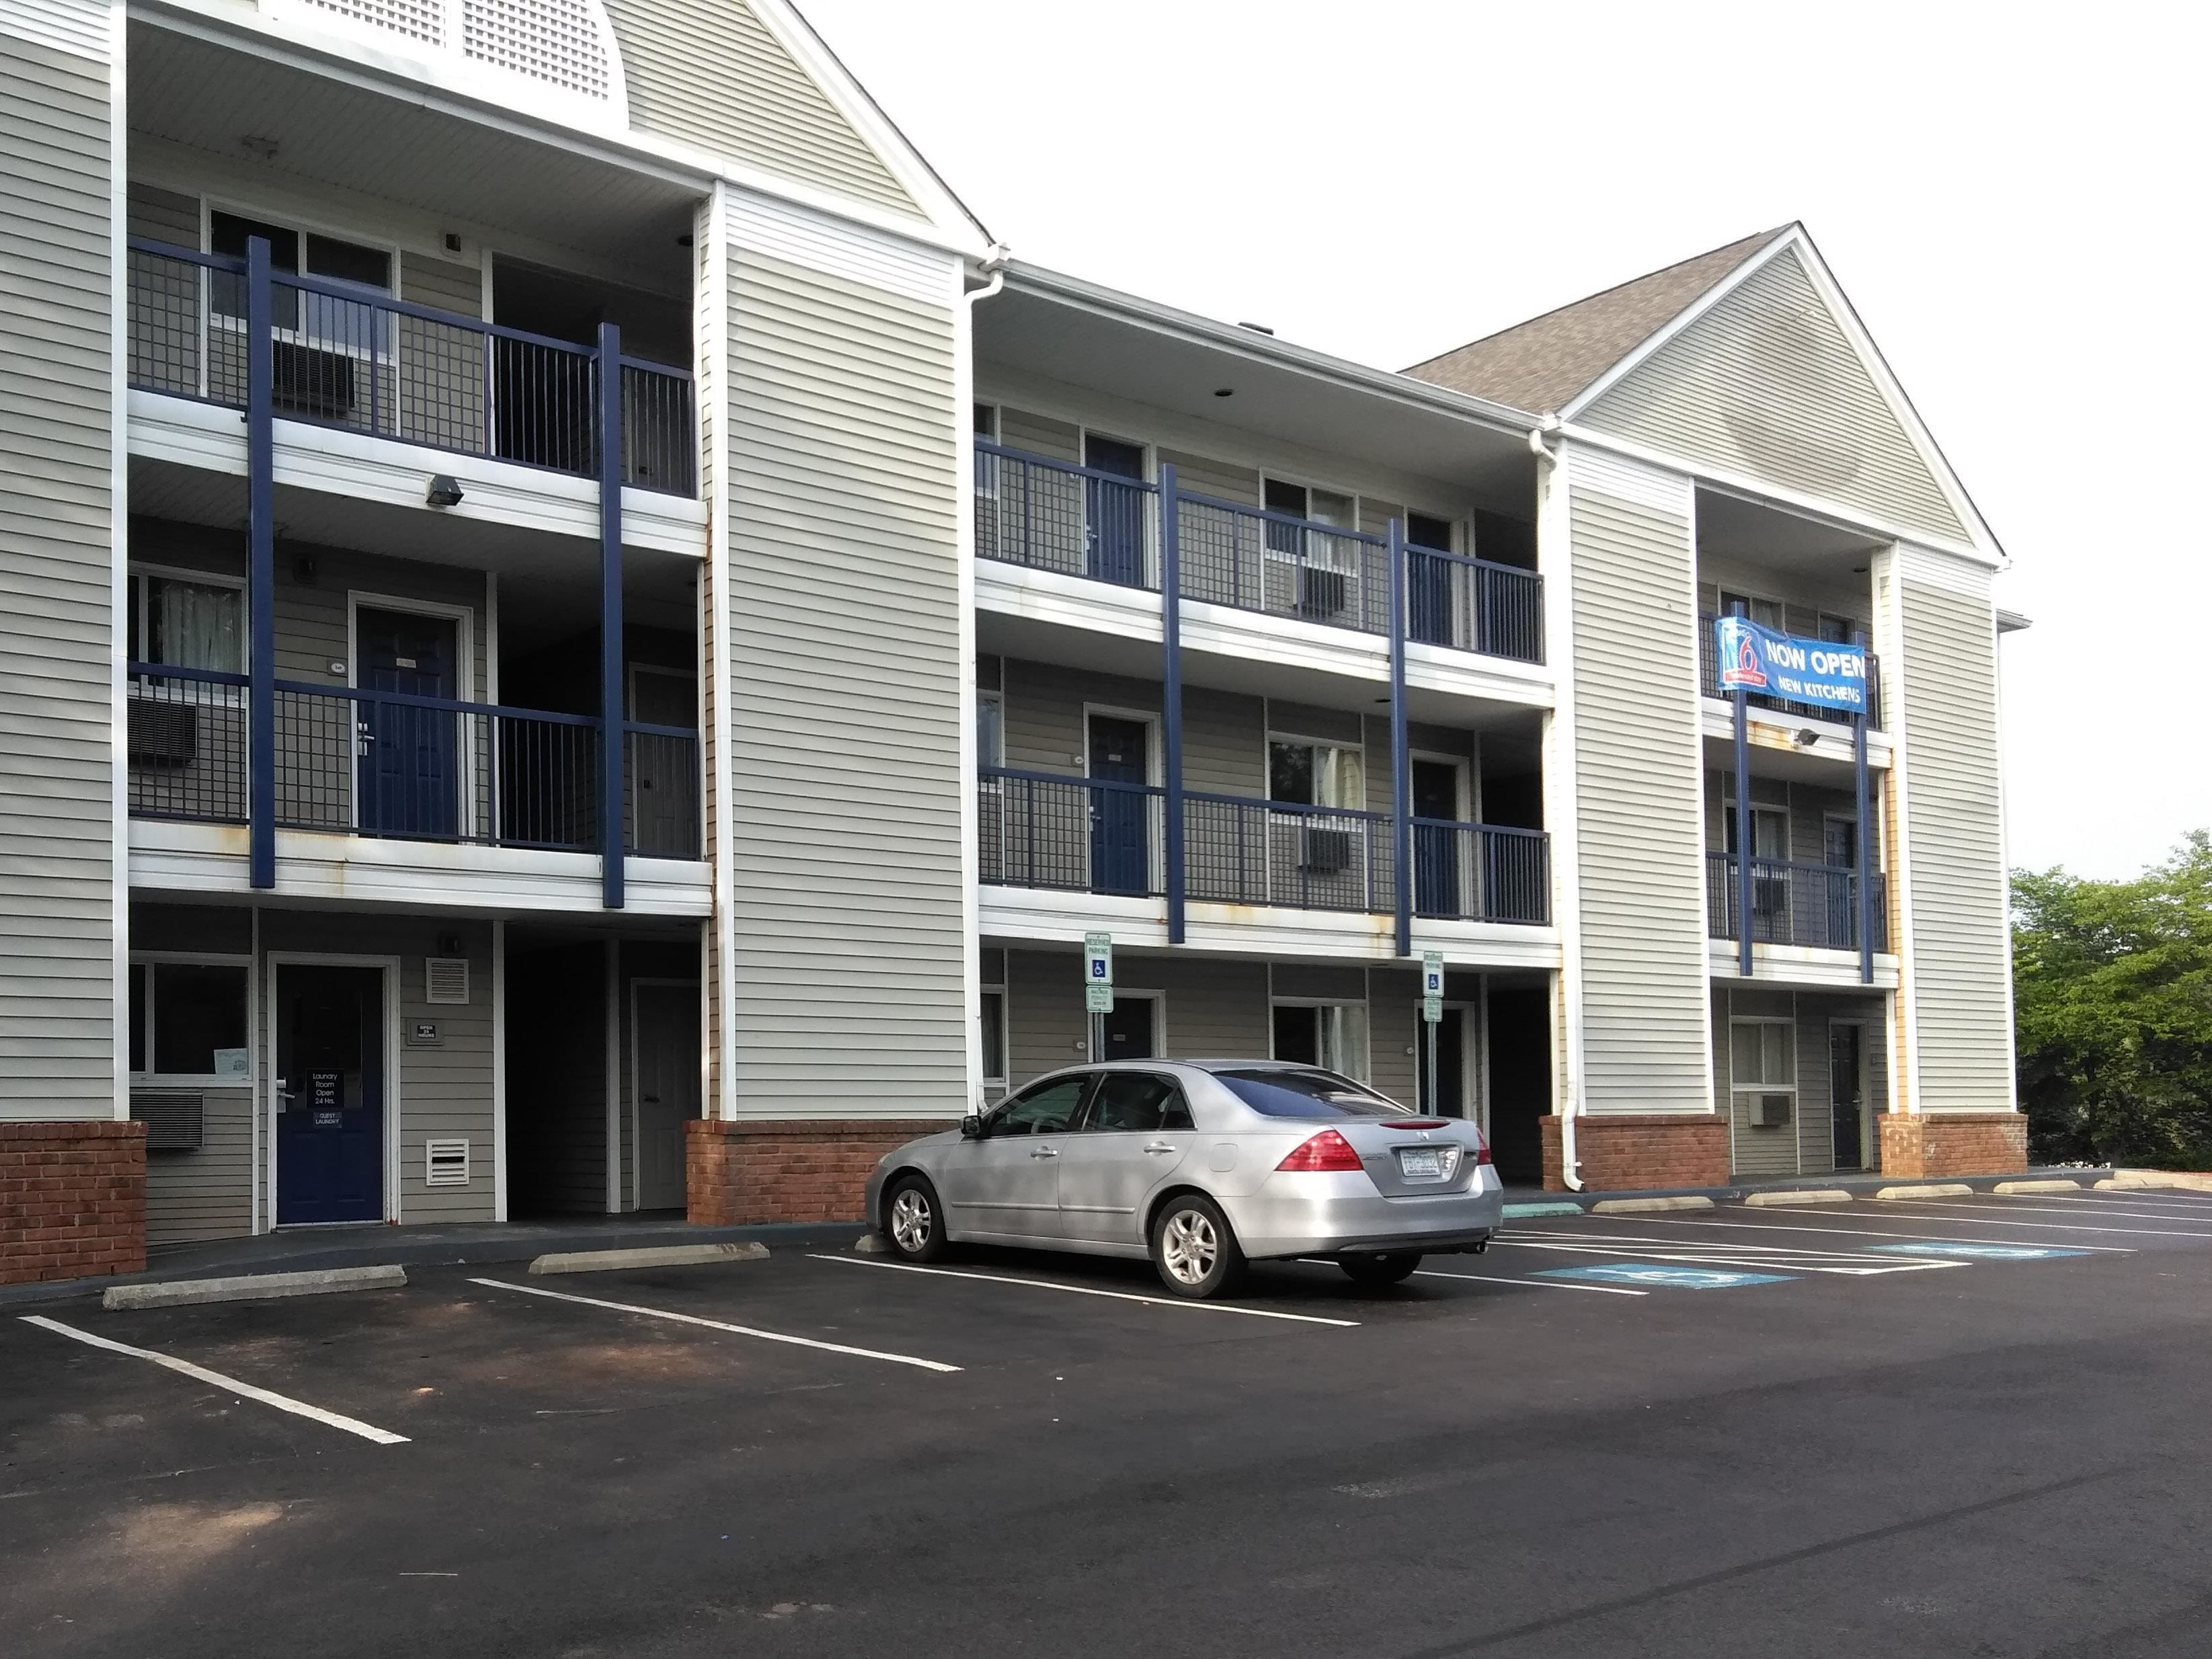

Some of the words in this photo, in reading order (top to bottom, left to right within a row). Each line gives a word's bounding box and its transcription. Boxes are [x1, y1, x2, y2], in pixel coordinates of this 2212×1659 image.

[1739, 635, 1757, 672] 6
[1766, 639, 1806, 671] NOW
[1811, 651, 1865, 678] OPEN
[1778, 675, 1802, 694] NEW
[1804, 682, 1861, 703] KITCHENS
